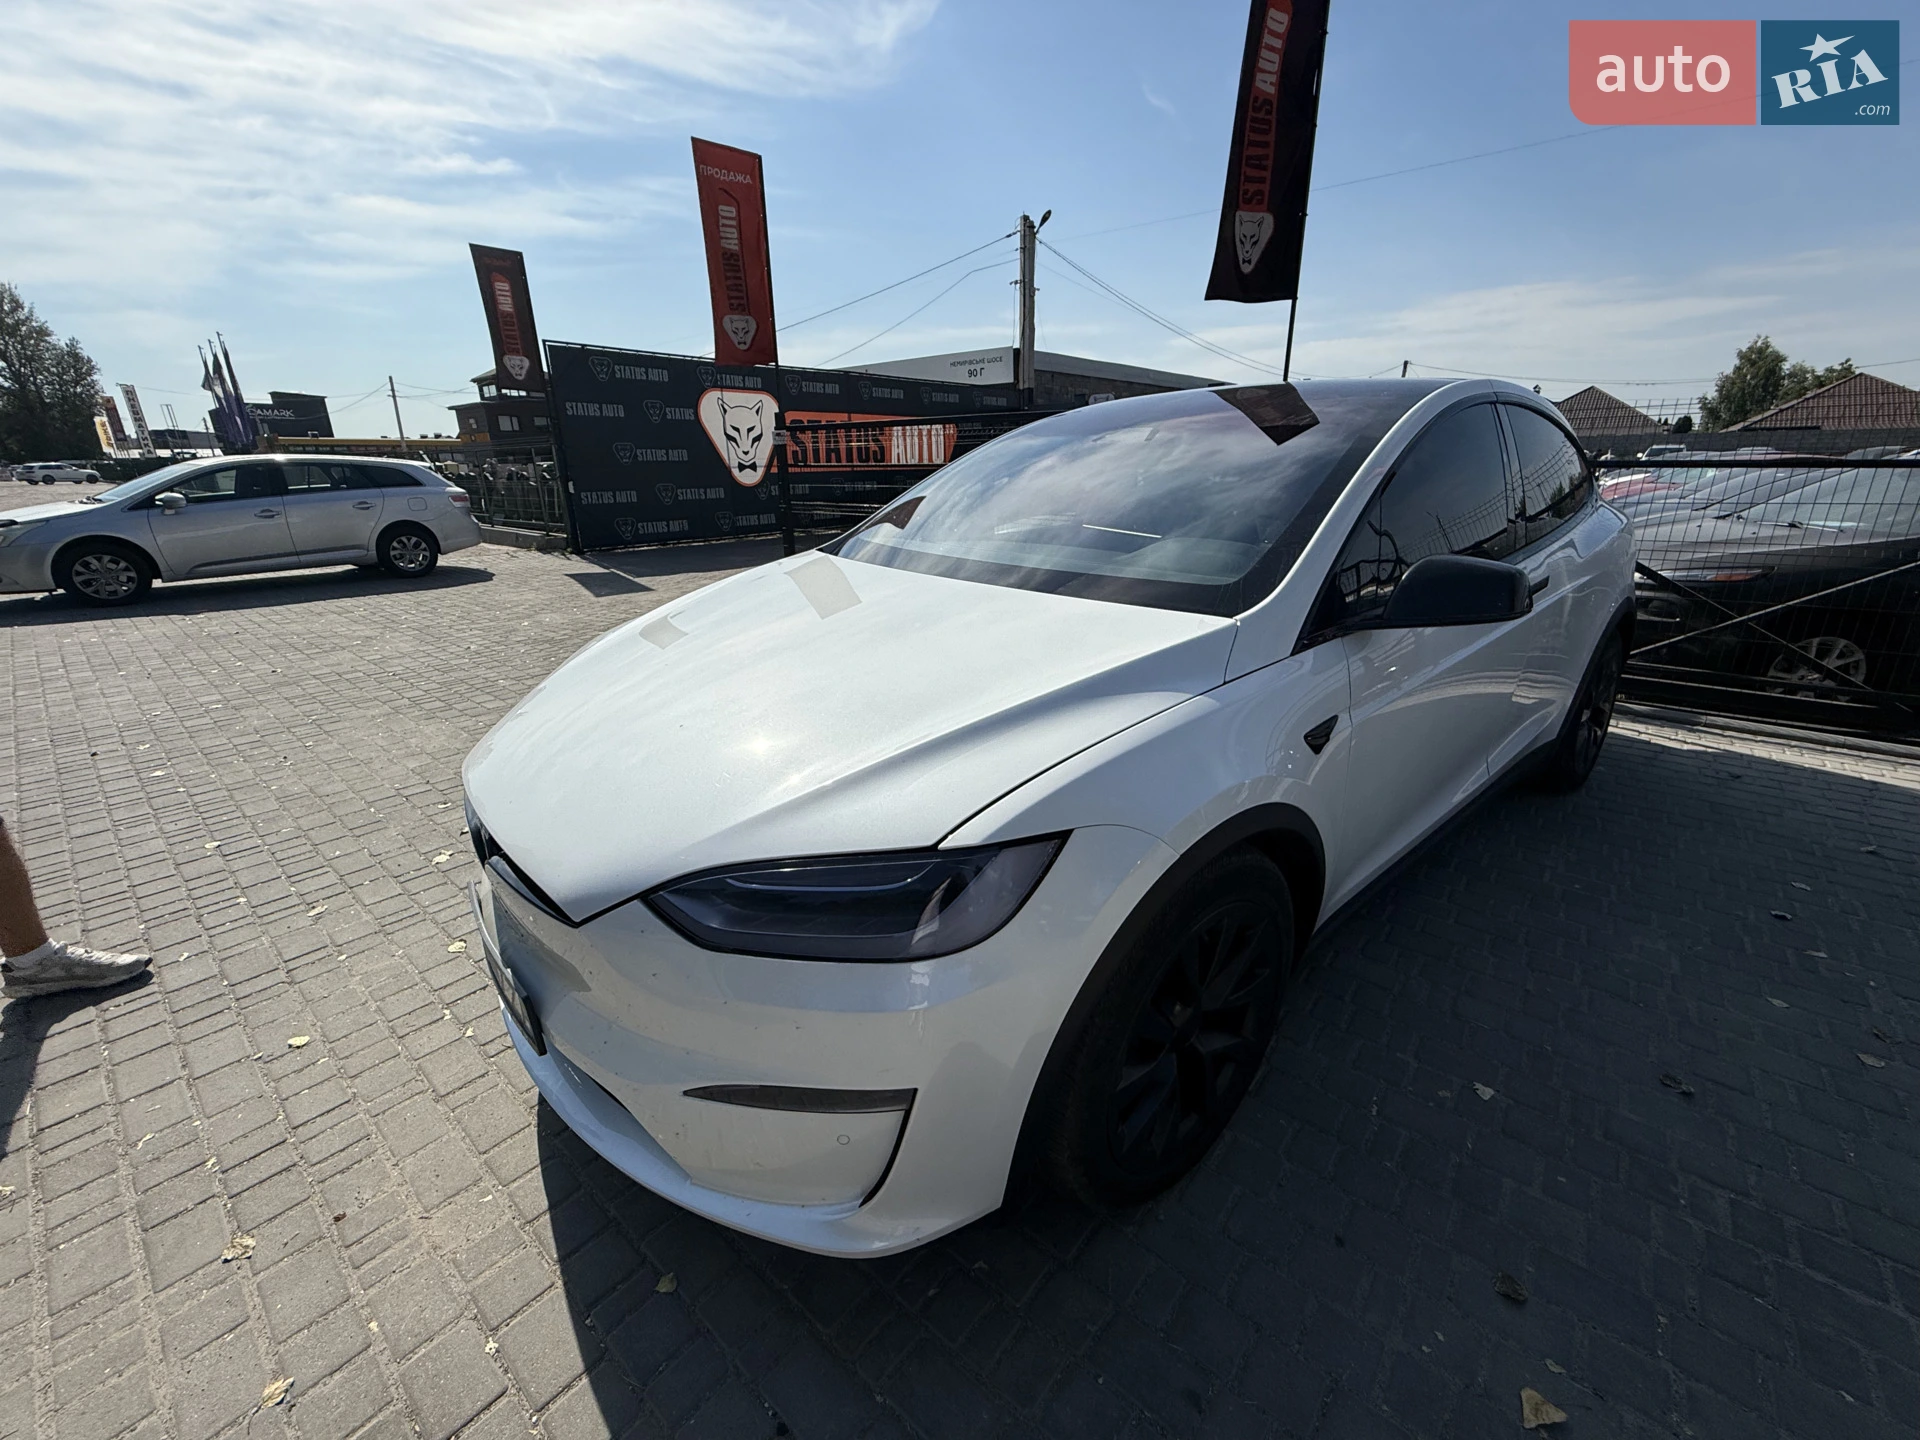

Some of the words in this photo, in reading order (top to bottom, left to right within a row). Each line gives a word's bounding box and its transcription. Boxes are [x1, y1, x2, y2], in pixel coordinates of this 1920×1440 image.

[1255, 7, 1289, 95] AUTO
[1241, 95, 1275, 206] STATUS
[699, 164, 753, 185] ПРОДАЖА
[717, 204, 739, 251] AUTO
[721, 250, 747, 316] STATUS
[987, 356, 1003, 364] ШОСЕ
[614, 364, 646, 381] STATUS
[648, 367, 669, 382] AUTO
[967, 368, 978, 378] 90
[744, 376, 762, 389] AUTO
[802, 381, 824, 394] STATUS
[825, 383, 840, 395] AUTO
[566, 401, 600, 417] STATUS
[602, 403, 625, 418] AUTO
[665, 407, 695, 420] STATUS
[125, 389, 154, 455] ПНЕВМАТИКА
[789, 418, 886, 465] STATUS
[891, 423, 945, 465] AUTO
[636, 448, 667, 462] STATUS
[668, 448, 689, 461] AUTO
[581, 490, 615, 505] STATUS
[616, 489, 638, 503] AUTO
[706, 487, 725, 499] AUTO
[637, 521, 668, 534] STATUS
[669, 520, 689, 532] AUTO
[759, 513, 776, 525] AUTO
